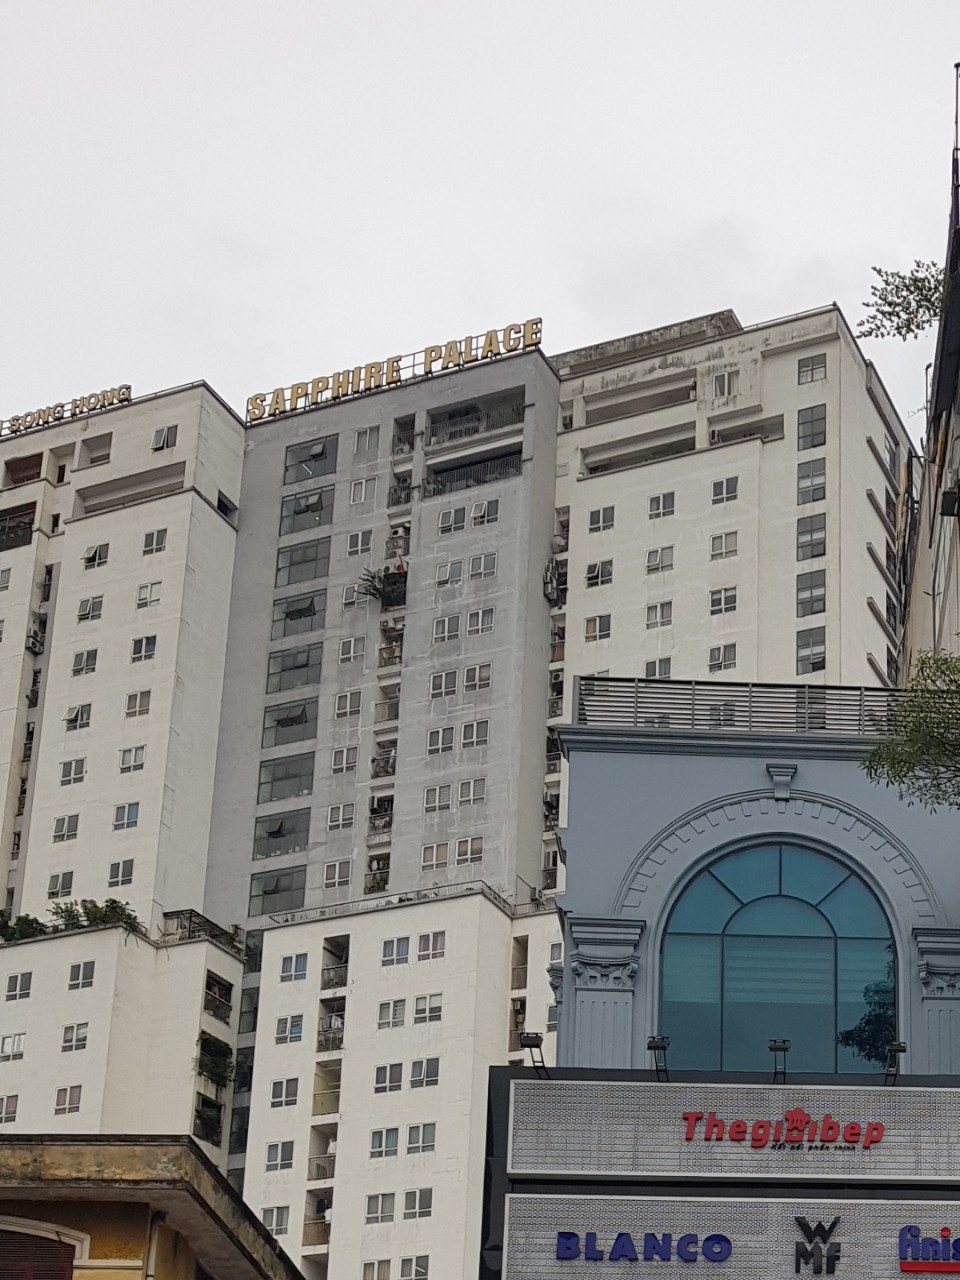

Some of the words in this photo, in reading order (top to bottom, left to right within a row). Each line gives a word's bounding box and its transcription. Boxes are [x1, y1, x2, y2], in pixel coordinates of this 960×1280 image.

[248, 355, 402, 420] SAPPHIRE
[423, 317, 542, 373] PALACE
[555, 1231, 733, 1264] BLANCO
